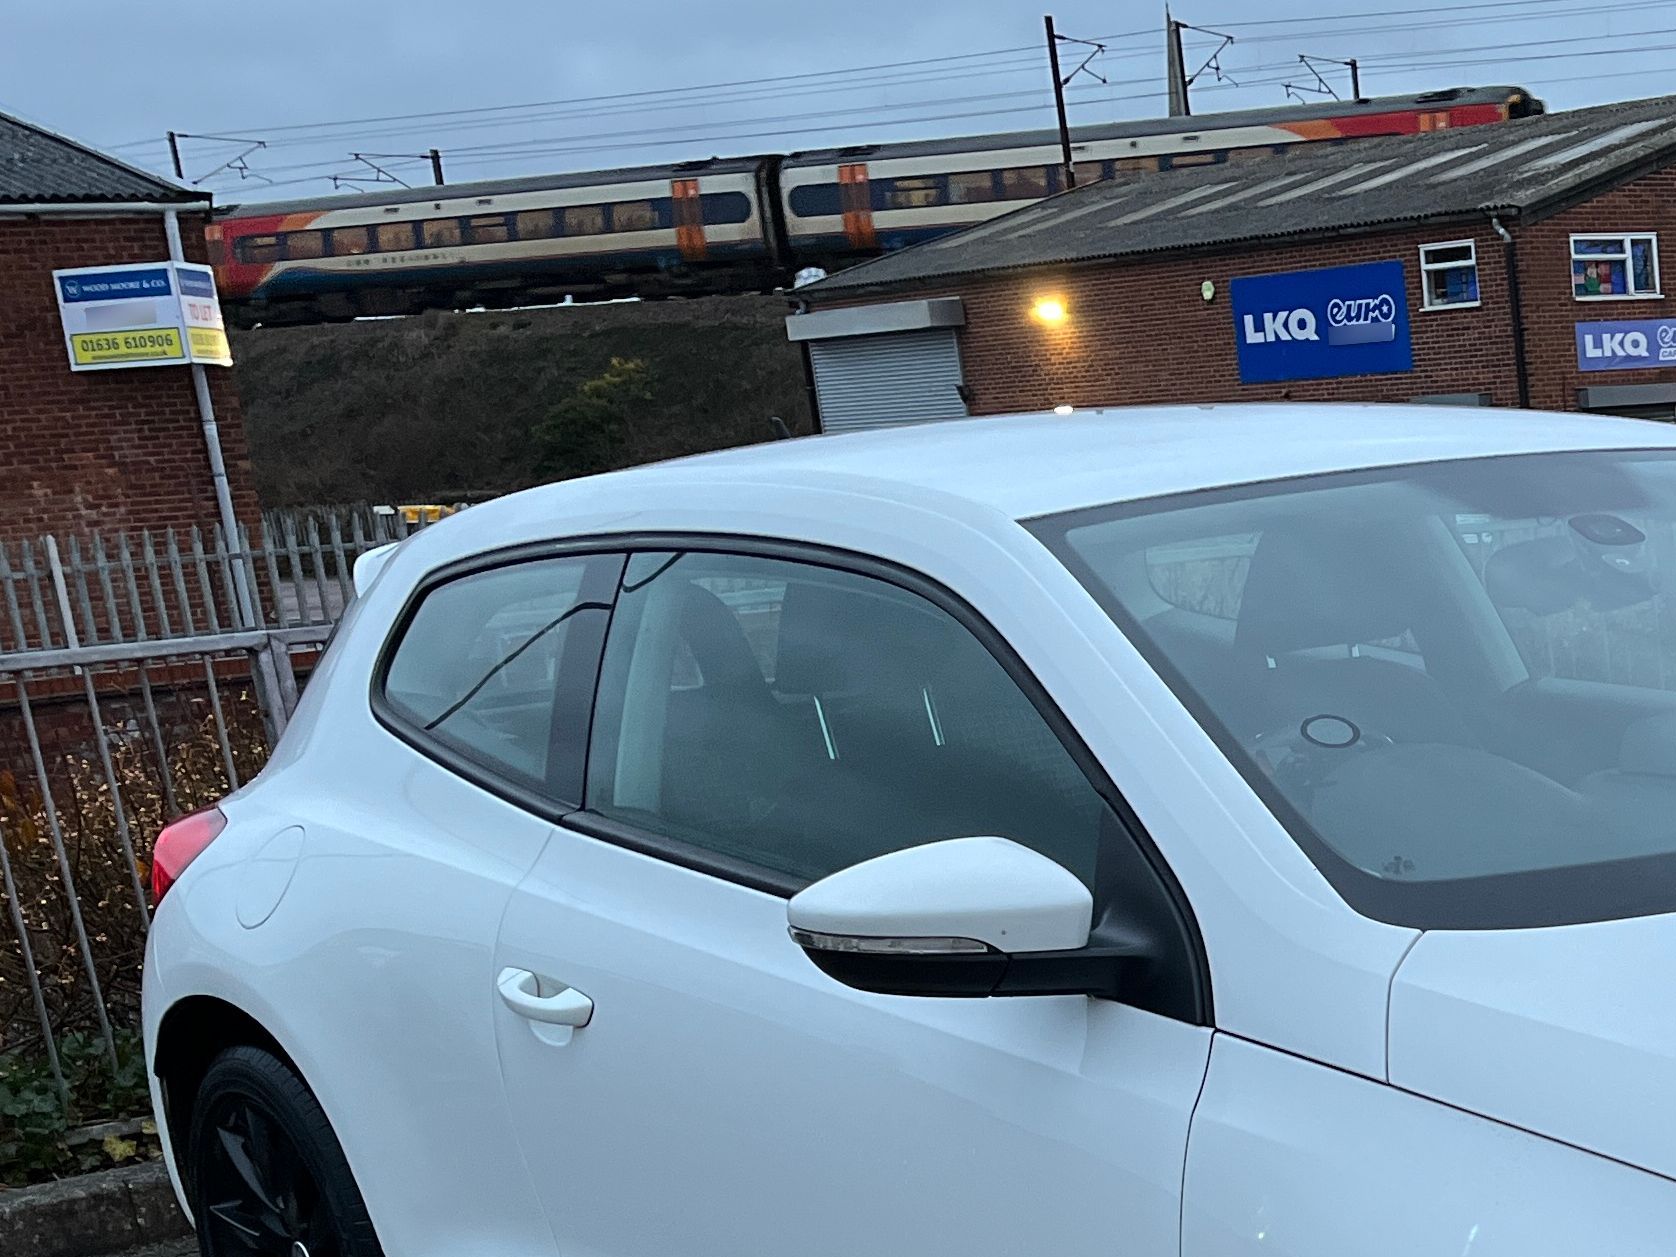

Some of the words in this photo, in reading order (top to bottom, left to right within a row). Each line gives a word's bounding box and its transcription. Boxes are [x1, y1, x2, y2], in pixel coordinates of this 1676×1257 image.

[1243, 308, 1321, 344] LKQ
[1327, 294, 1396, 327] euro
[81, 336, 121, 352] 01636
[124, 333, 174, 350] 610906
[1584, 331, 1650, 358] LKQ
